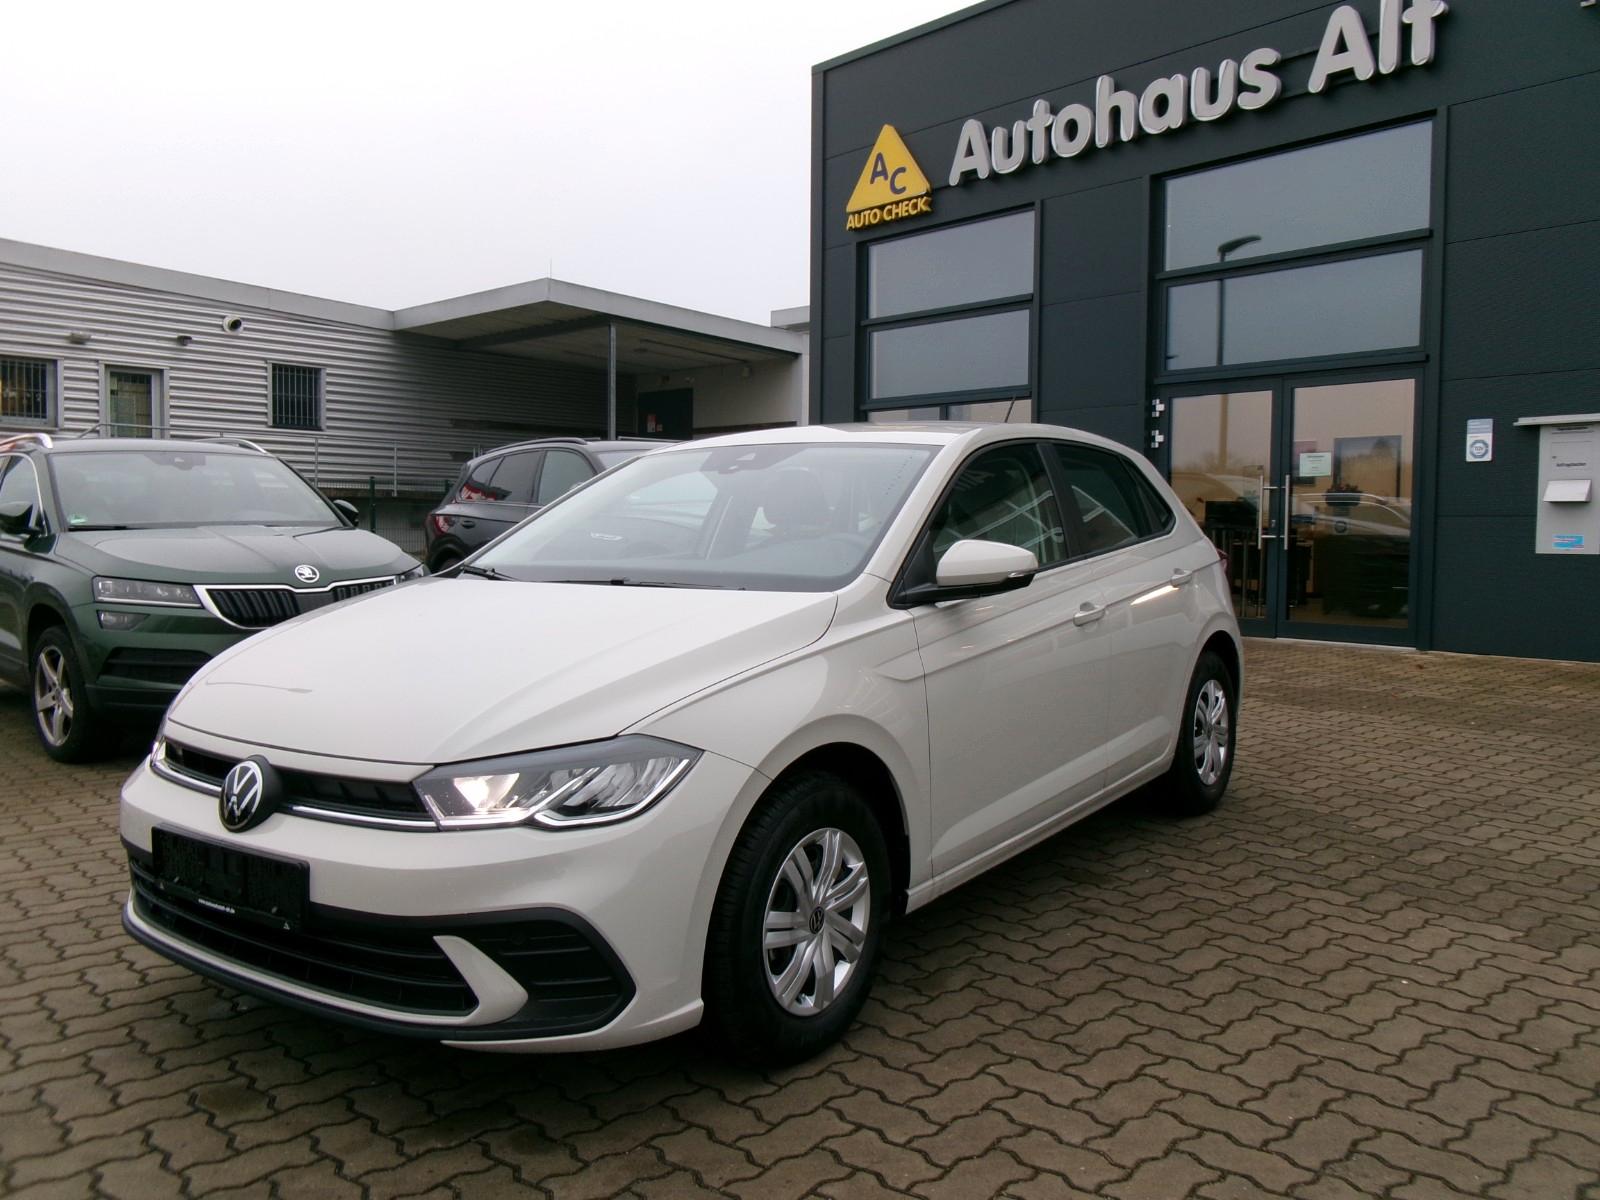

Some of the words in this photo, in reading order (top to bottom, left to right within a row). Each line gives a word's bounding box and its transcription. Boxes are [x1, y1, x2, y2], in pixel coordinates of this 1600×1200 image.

[948, 48, 1282, 186] Autohaus
[1307, 0, 1449, 93] Alt
[846, 208, 880, 230] AUTO
[883, 196, 932, 221] CHECK
